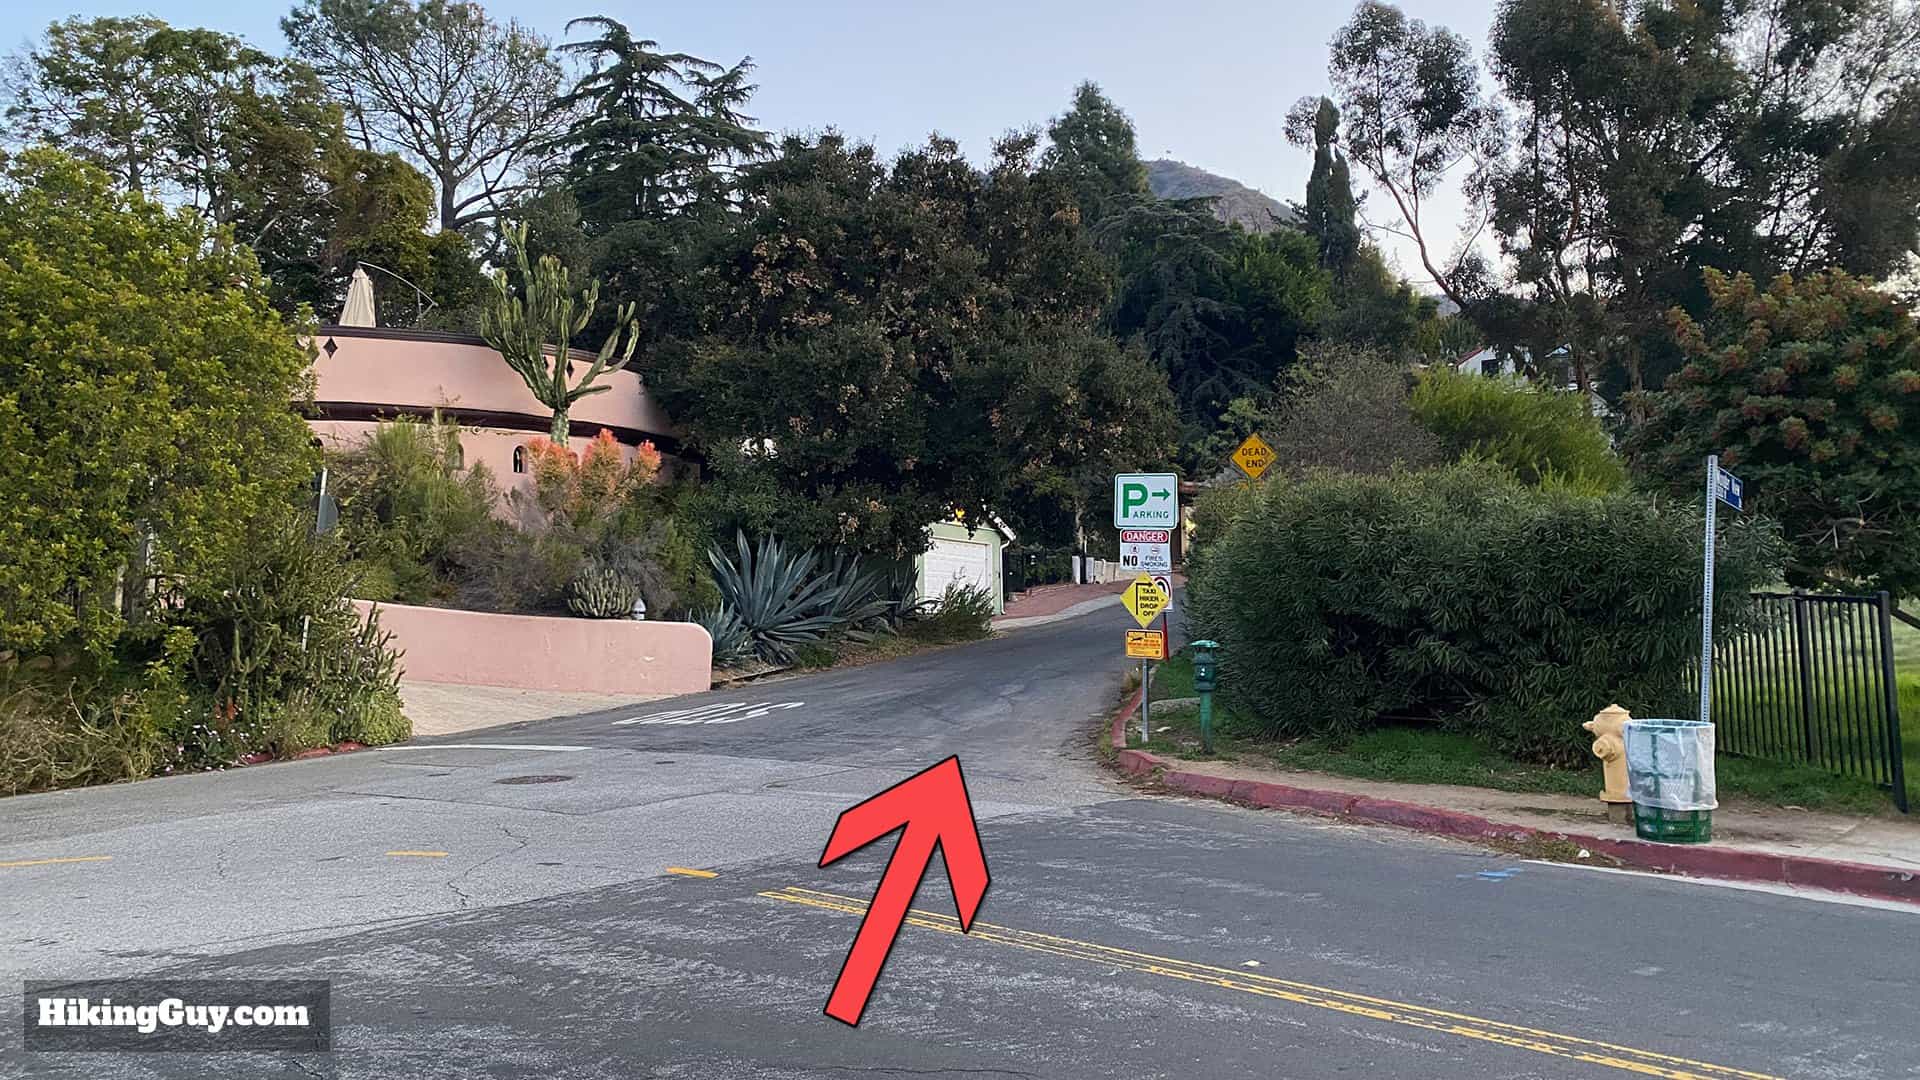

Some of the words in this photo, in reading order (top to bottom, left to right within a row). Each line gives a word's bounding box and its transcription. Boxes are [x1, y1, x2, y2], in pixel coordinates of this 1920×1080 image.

[1241, 447, 1267, 457] DEAD
[1246, 459, 1265, 468] END
[1126, 531, 1164, 541] DANGER
[1123, 555, 1138, 567] NO
